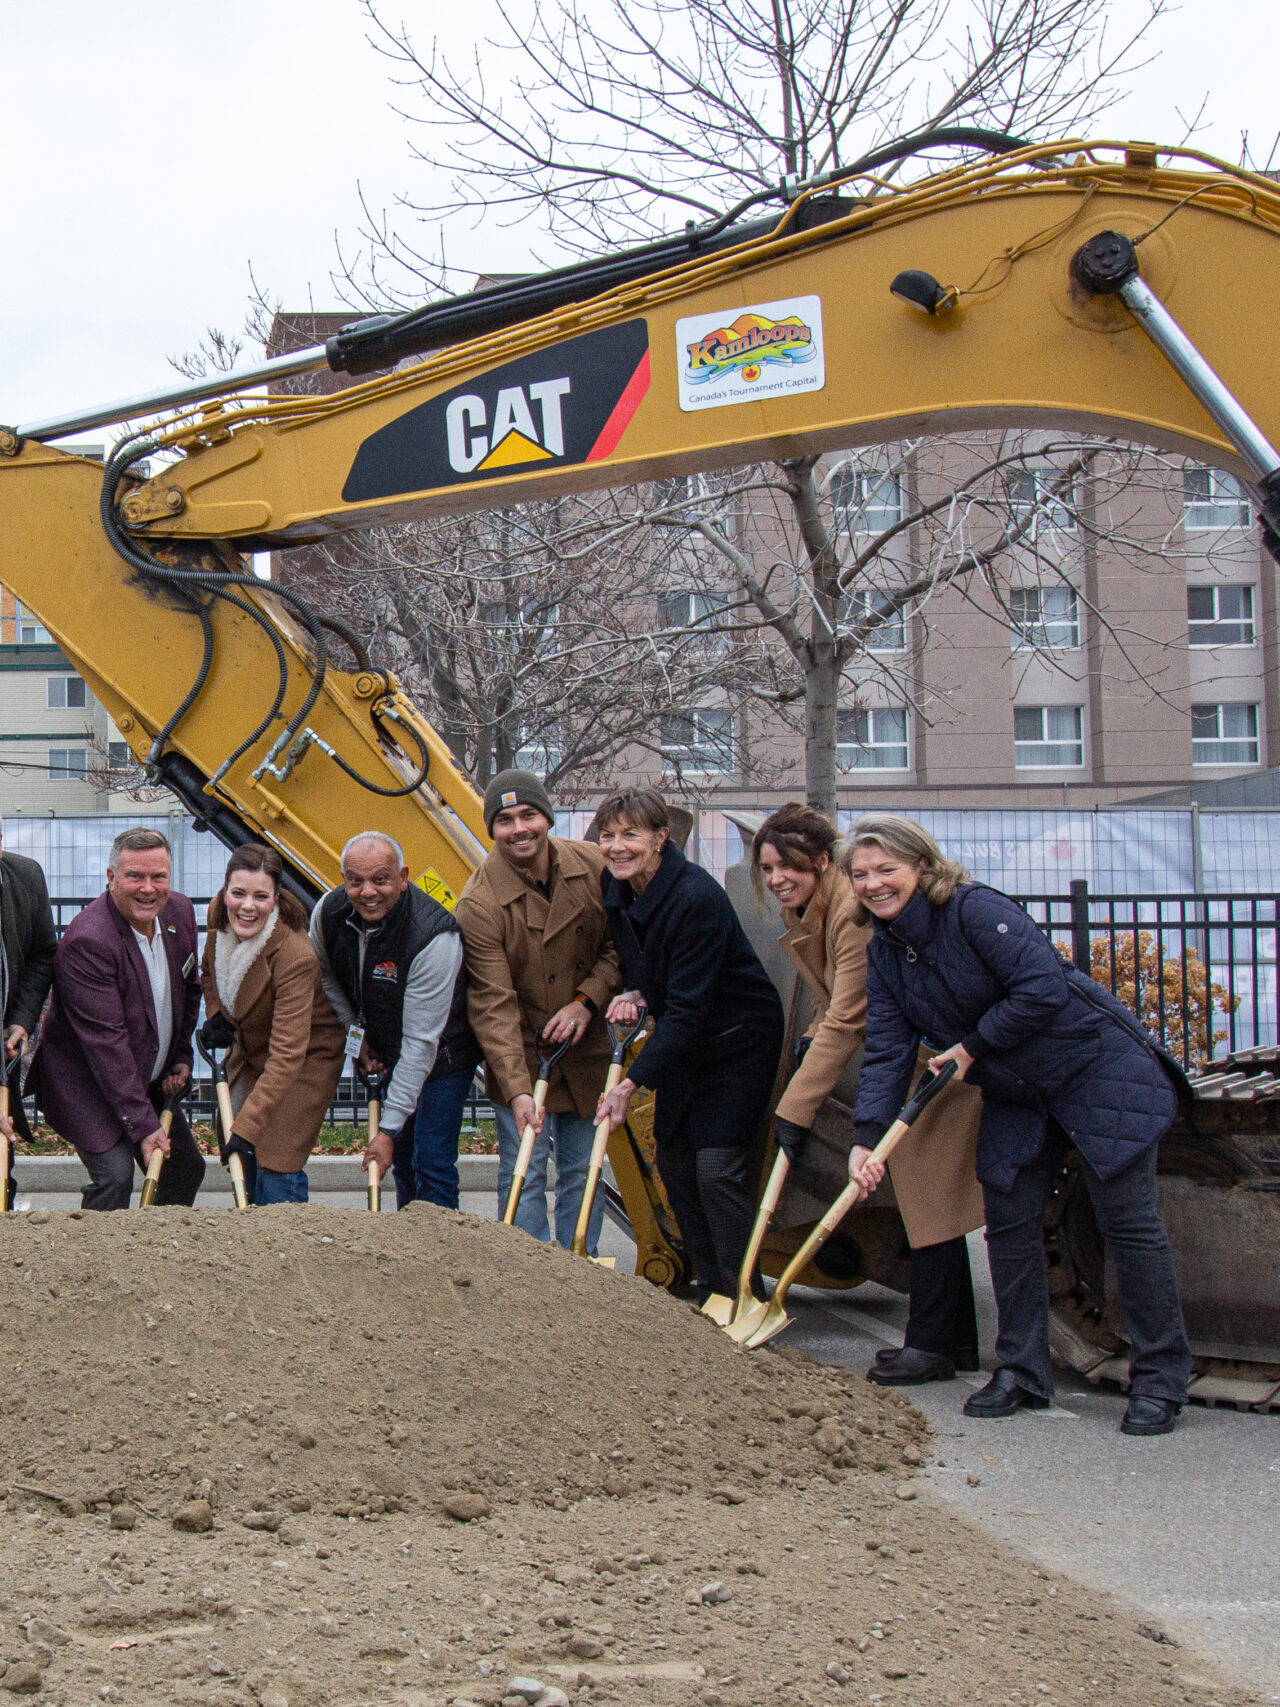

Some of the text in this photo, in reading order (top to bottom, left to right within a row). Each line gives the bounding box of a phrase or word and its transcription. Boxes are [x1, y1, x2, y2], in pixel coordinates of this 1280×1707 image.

[687, 325, 812, 369] Kamloops
[689, 376, 818, 403] Canada's Tournament Capital
[446, 377, 571, 473] CAT
